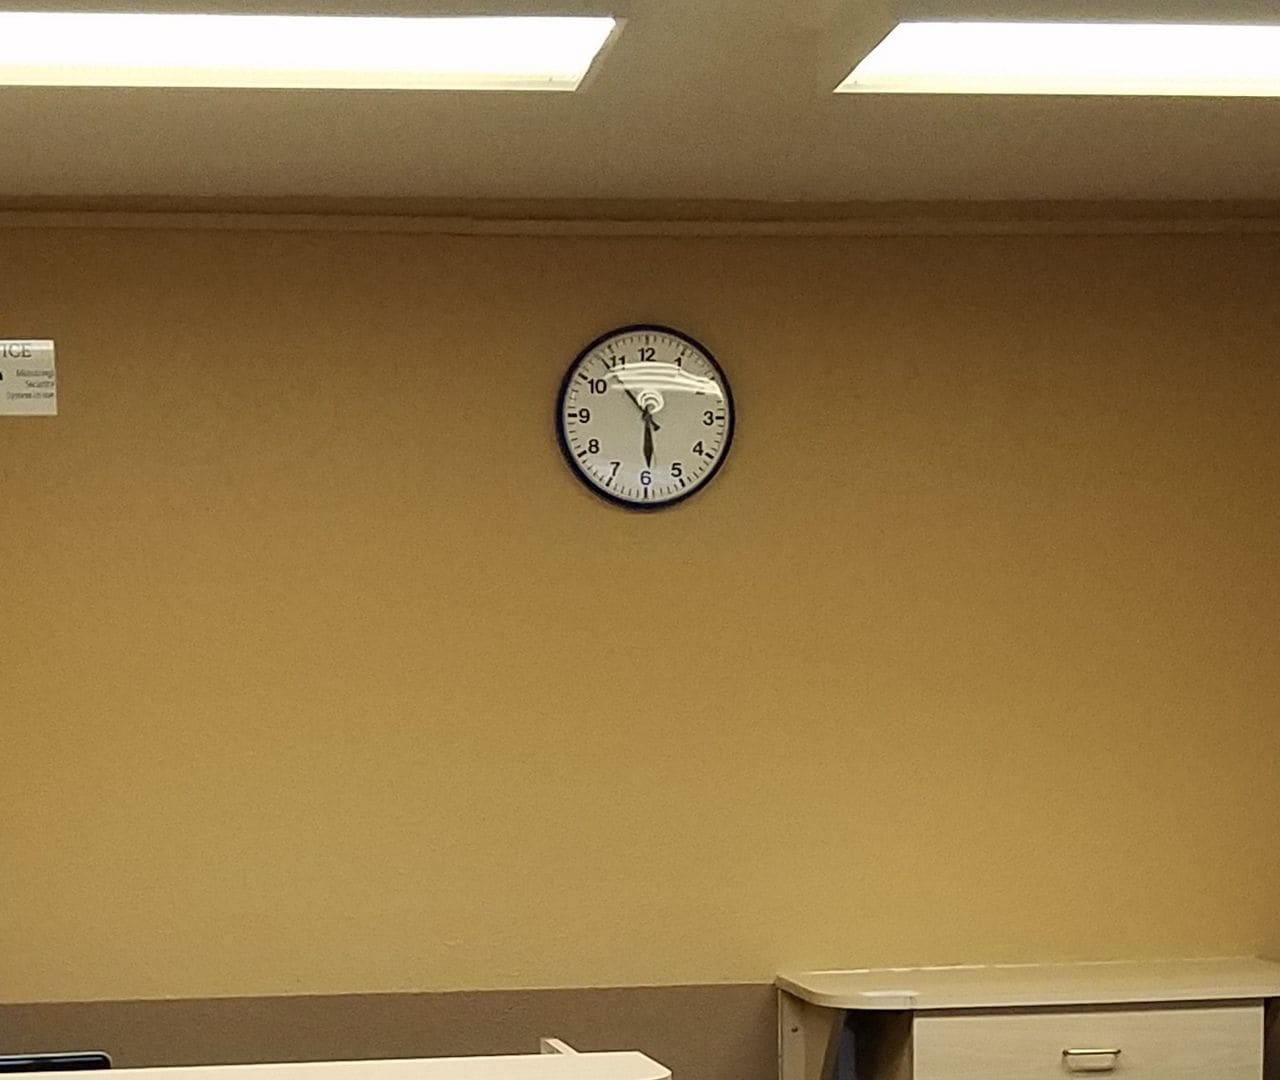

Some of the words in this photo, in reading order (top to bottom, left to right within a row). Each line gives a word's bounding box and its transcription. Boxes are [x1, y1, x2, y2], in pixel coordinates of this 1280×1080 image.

[638, 347, 656, 362] 12
[610, 356, 626, 369] 11
[587, 379, 607, 394] 10
[578, 408, 590, 424] 9
[703, 410, 714, 426] 3
[588, 439, 600, 454] 8
[692, 441, 704, 456] 4
[610, 461, 621, 477] 7
[671, 462, 682, 478] 5
[640, 471, 652, 486] 6
